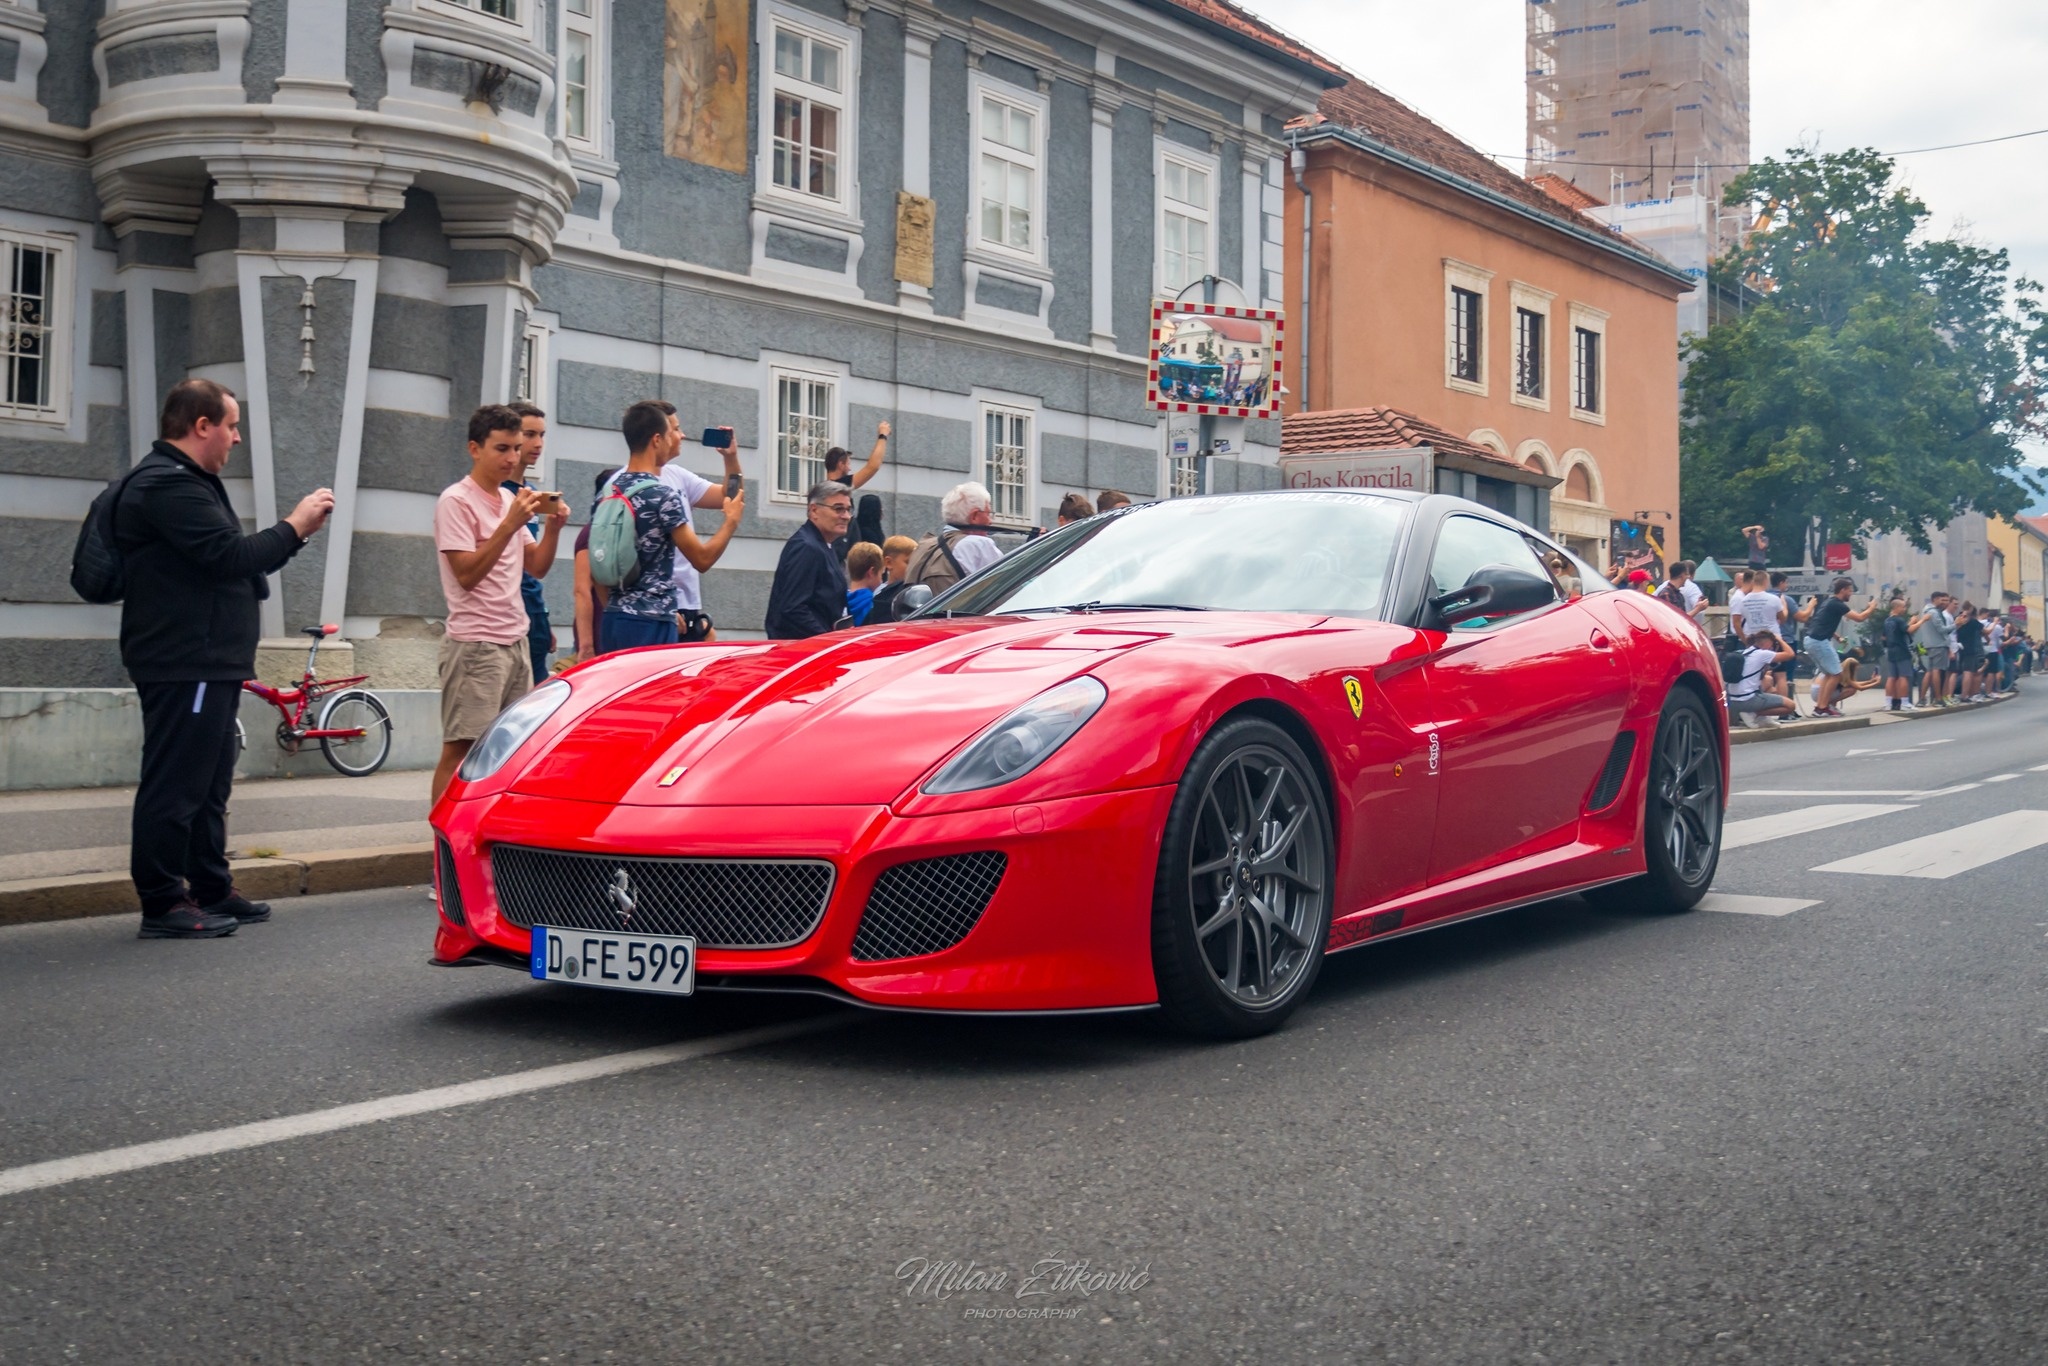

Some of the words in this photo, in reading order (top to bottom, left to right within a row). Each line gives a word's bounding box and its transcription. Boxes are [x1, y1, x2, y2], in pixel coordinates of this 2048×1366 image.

[1291, 470, 1332, 489] Glas
[1336, 465, 1414, 489] Koncila
[536, 957, 543, 969] D
[548, 934, 563, 973] D
[582, 938, 620, 980] FE
[627, 942, 690, 985] 599
